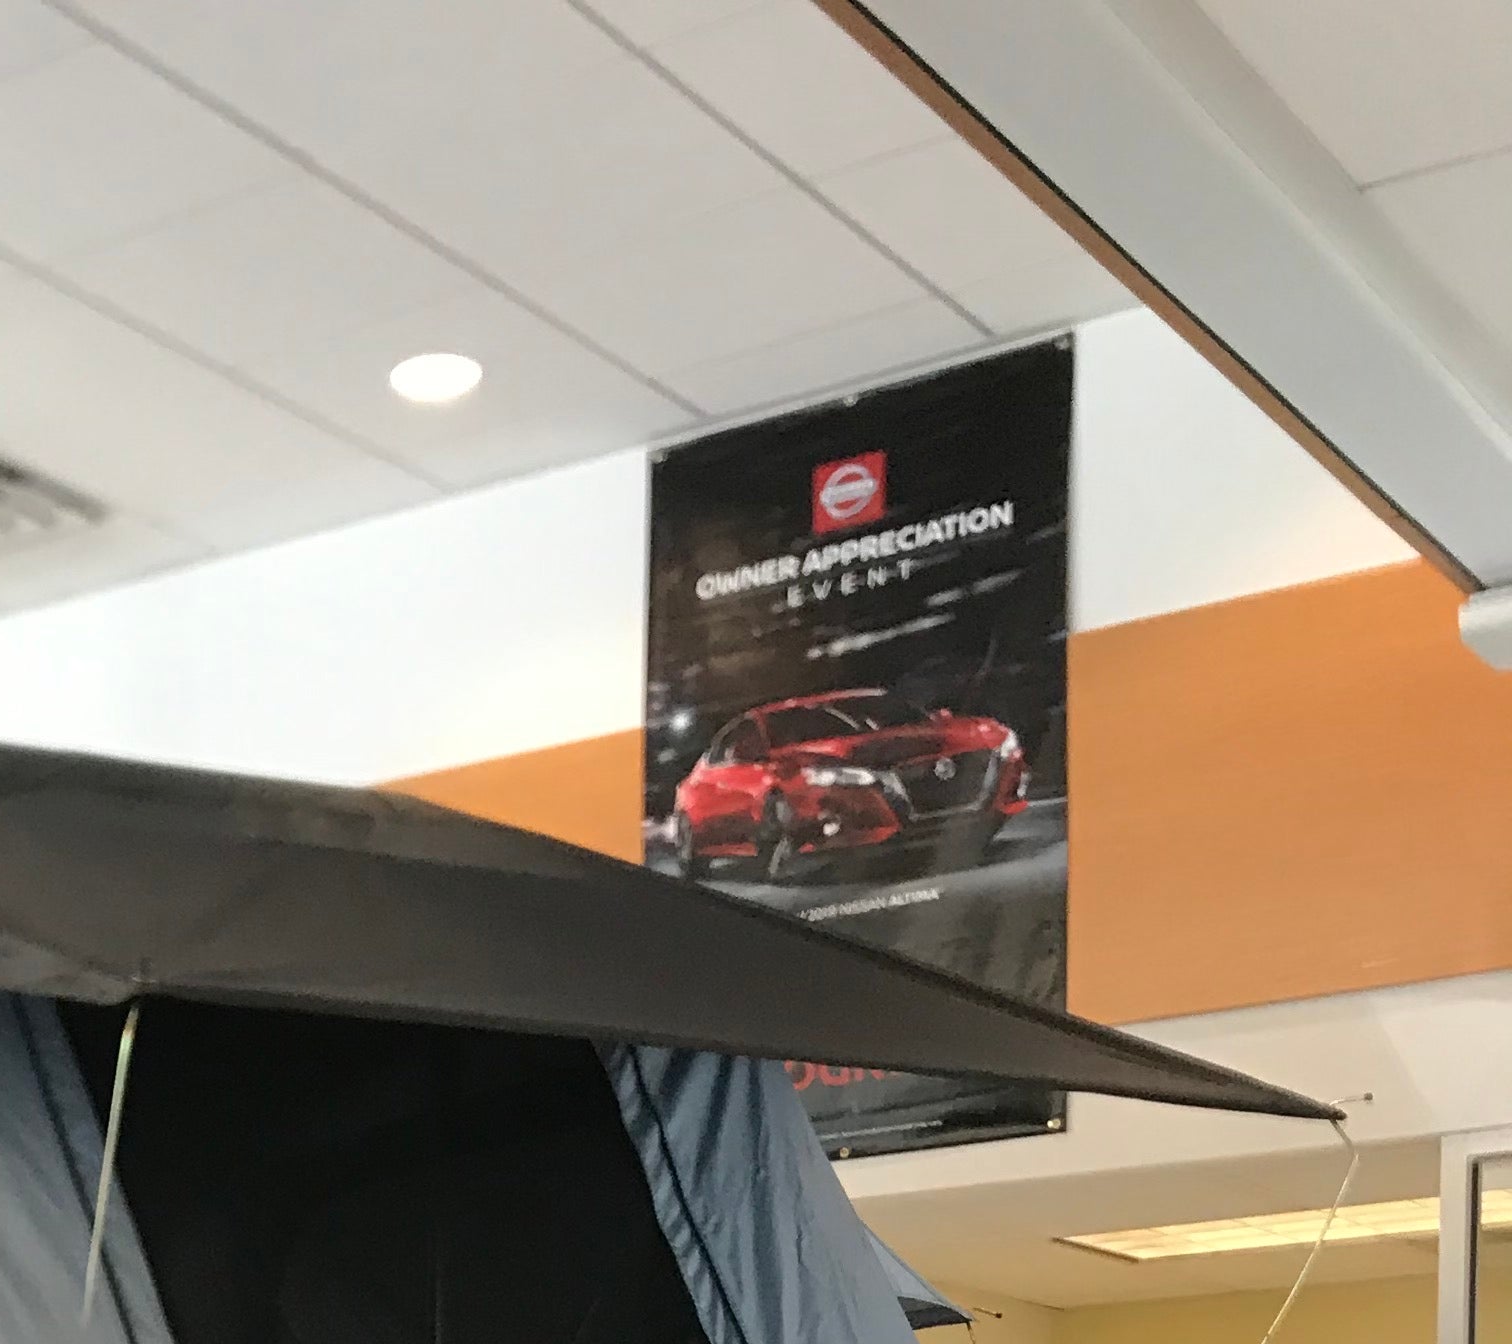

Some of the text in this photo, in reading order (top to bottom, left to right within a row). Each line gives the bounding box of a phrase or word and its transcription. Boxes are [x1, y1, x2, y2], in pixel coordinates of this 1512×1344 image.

[695, 500, 1015, 600] OWNER APPRECIATION
[787, 558, 912, 609] EVENT
